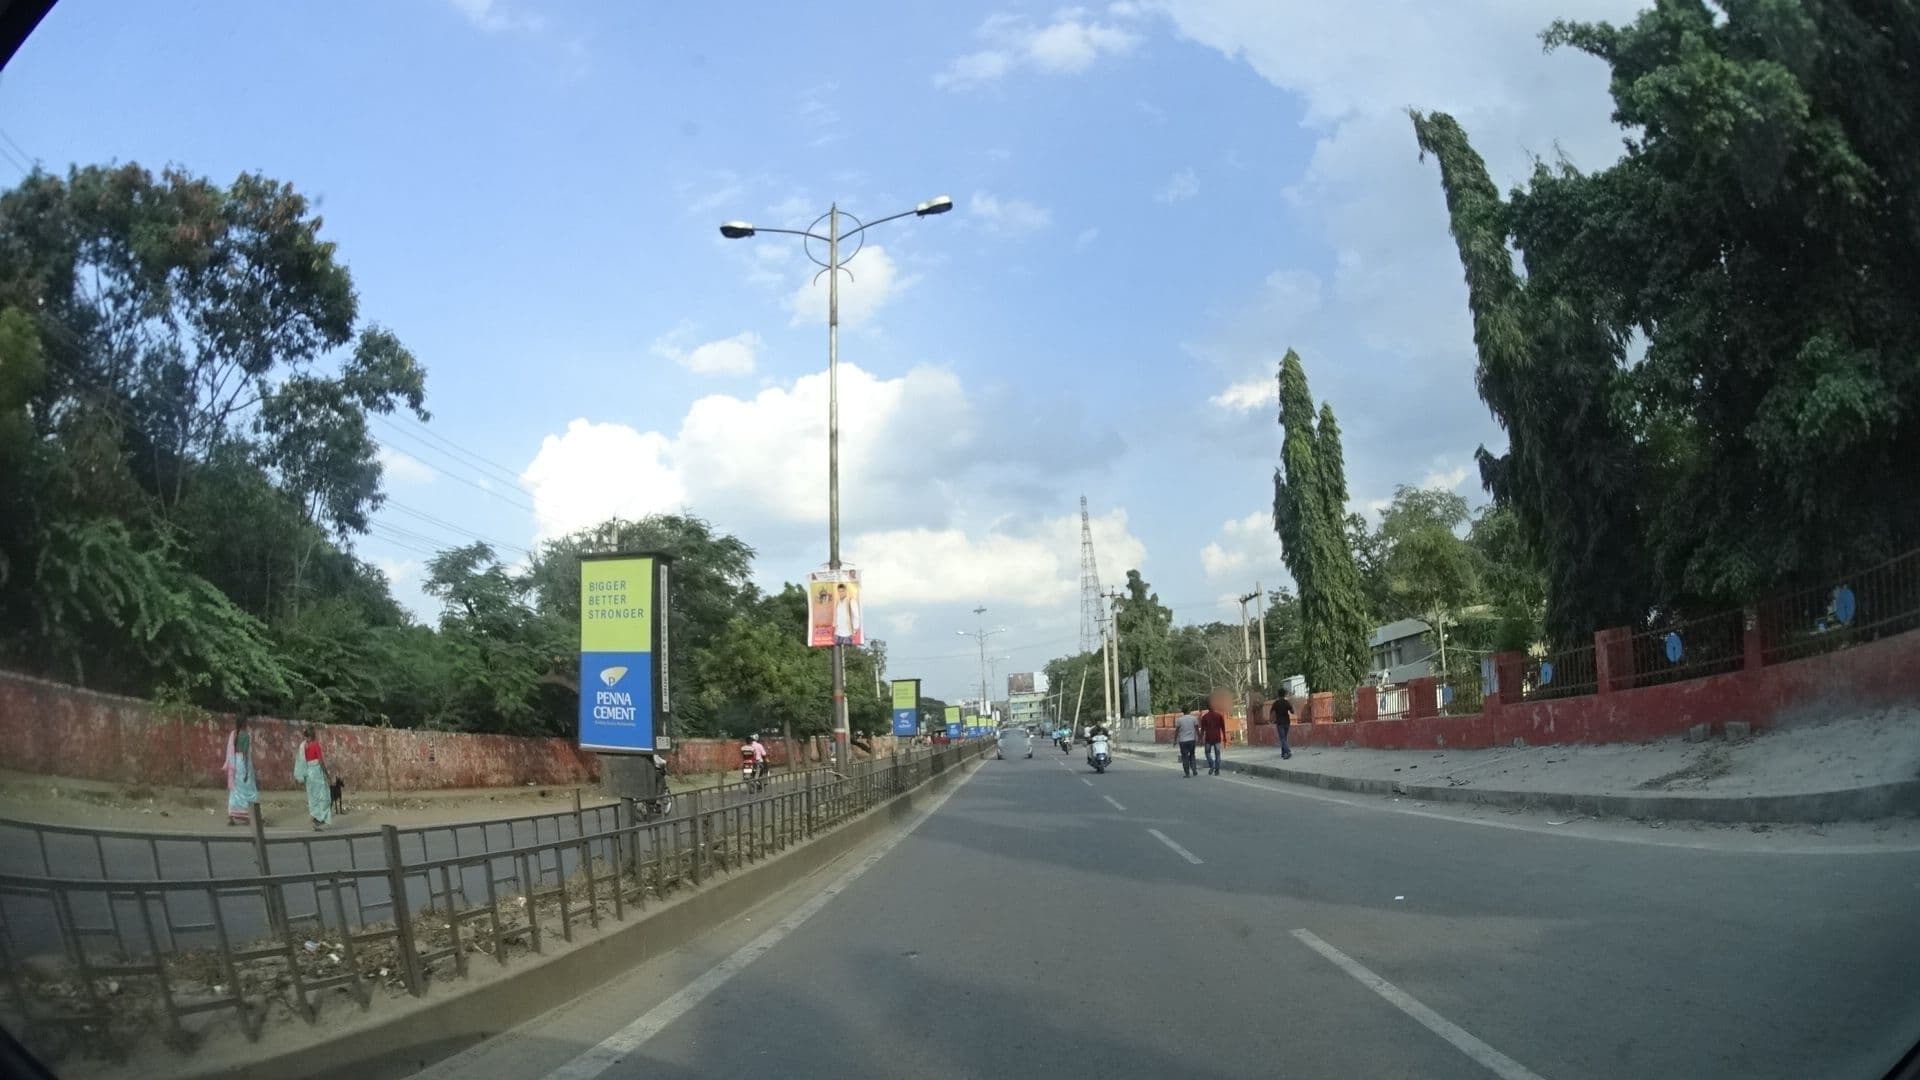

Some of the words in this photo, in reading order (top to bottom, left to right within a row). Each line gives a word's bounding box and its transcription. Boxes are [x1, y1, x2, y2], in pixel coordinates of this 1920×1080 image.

[589, 581, 626, 592] BIGGER
[588, 595, 626, 606] BETTER
[588, 608, 644, 619] STRONGER
[596, 691, 632, 706] PENNA
[593, 706, 636, 720] CEMENT
